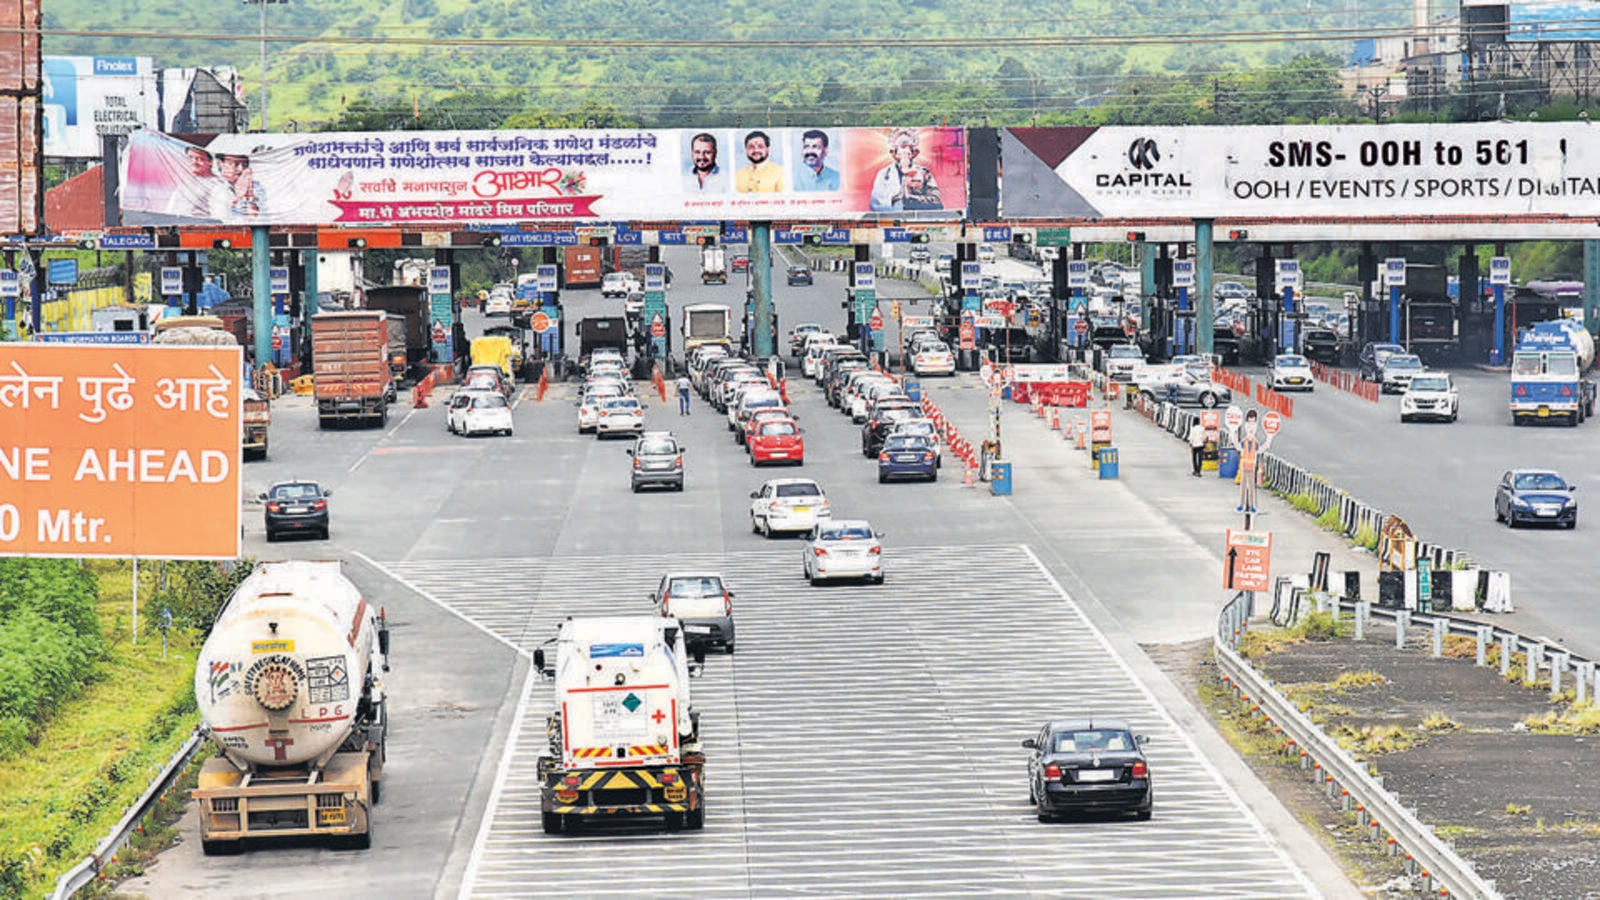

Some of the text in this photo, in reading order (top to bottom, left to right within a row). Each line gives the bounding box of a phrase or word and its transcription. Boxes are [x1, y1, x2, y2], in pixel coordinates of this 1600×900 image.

[94, 110, 138, 122] ELECTRICAL
[389, 138, 430, 154] आणि
[466, 136, 549, 152] सार्वजनिक
[553, 135, 594, 150] गणेश
[1268, 141, 1347, 168] SMS-
[1434, 141, 1463, 166] to
[475, 154, 524, 168] साजरा
[471, 167, 563, 198] आभार
[1096, 173, 1192, 187] CAPITAL
[1234, 180, 1290, 199] OOH
[1310, 179, 1396, 198] EVENTS
[1415, 178, 1499, 197] SPORTS
[617, 233, 638, 242] LCV
[825, 231, 846, 240] CAR
[0, 360, 232, 423] लेन पुढे आहे
[74, 448, 230, 484] AHEAD
[37, 509, 112, 543] Mtr.
